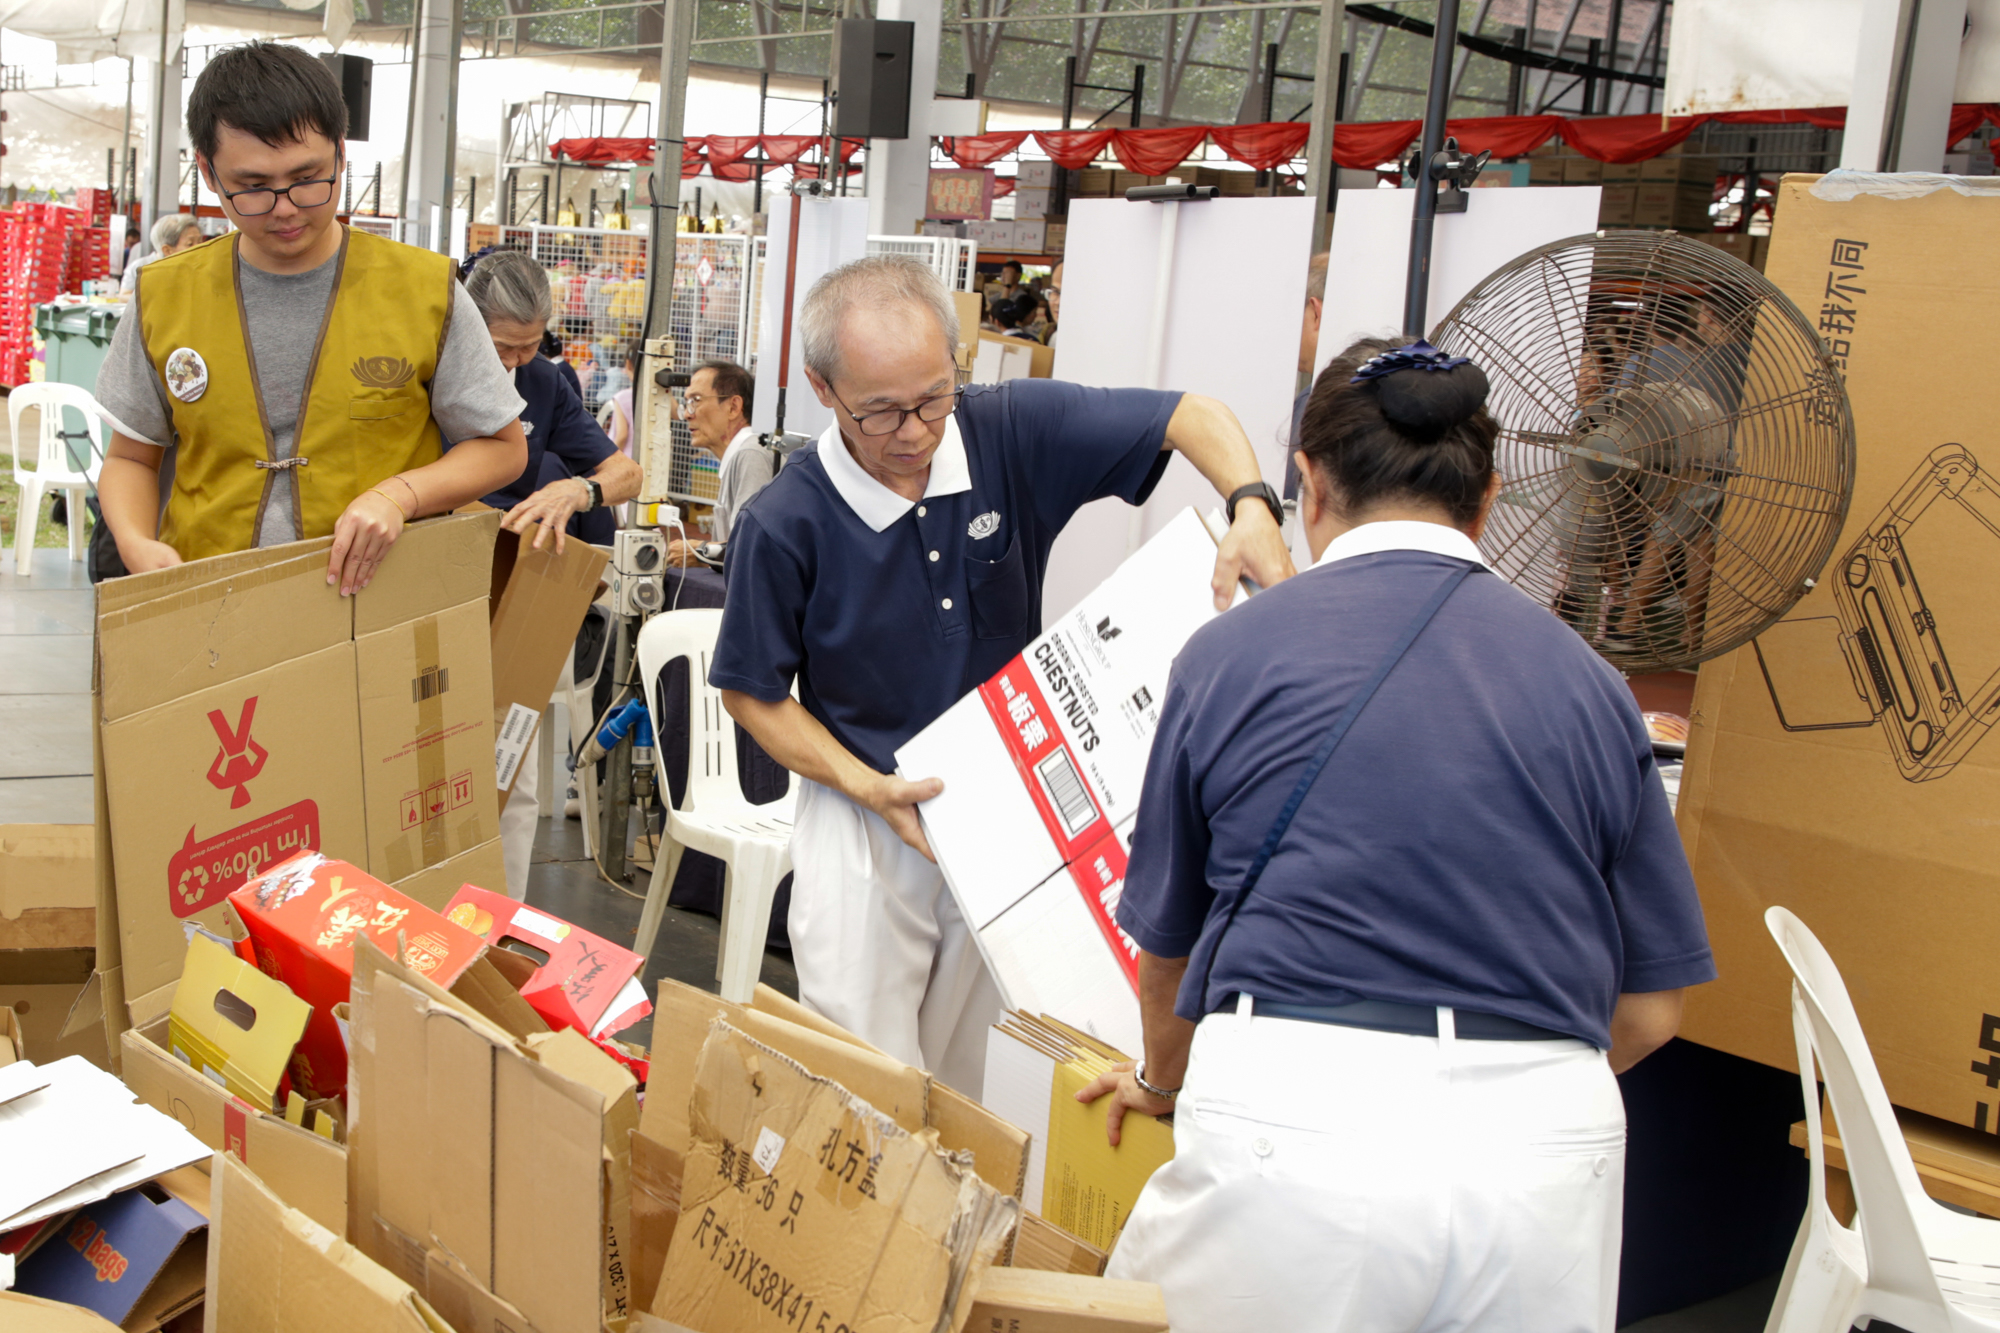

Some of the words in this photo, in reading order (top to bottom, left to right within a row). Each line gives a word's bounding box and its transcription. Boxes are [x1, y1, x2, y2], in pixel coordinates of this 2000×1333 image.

[1051, 632, 1076, 672] ORGANIC
[1072, 672, 1099, 716] ROASTED
[1034, 642, 1100, 753] CHESTNUTS
[273, 814, 294, 826] Consider
[241, 830, 250, 838] me
[250, 822, 273, 835] returning
[226, 836, 236, 845] our
[277, 824, 311, 851] I'm
[206, 840, 227, 854] delivery
[212, 842, 272, 883] 100%
[412, 935, 432, 951] SHEEP
[430, 944, 450, 959] LUCKY
[82, 1229, 129, 1283] bags
[608, 1262, 625, 1287] 320
